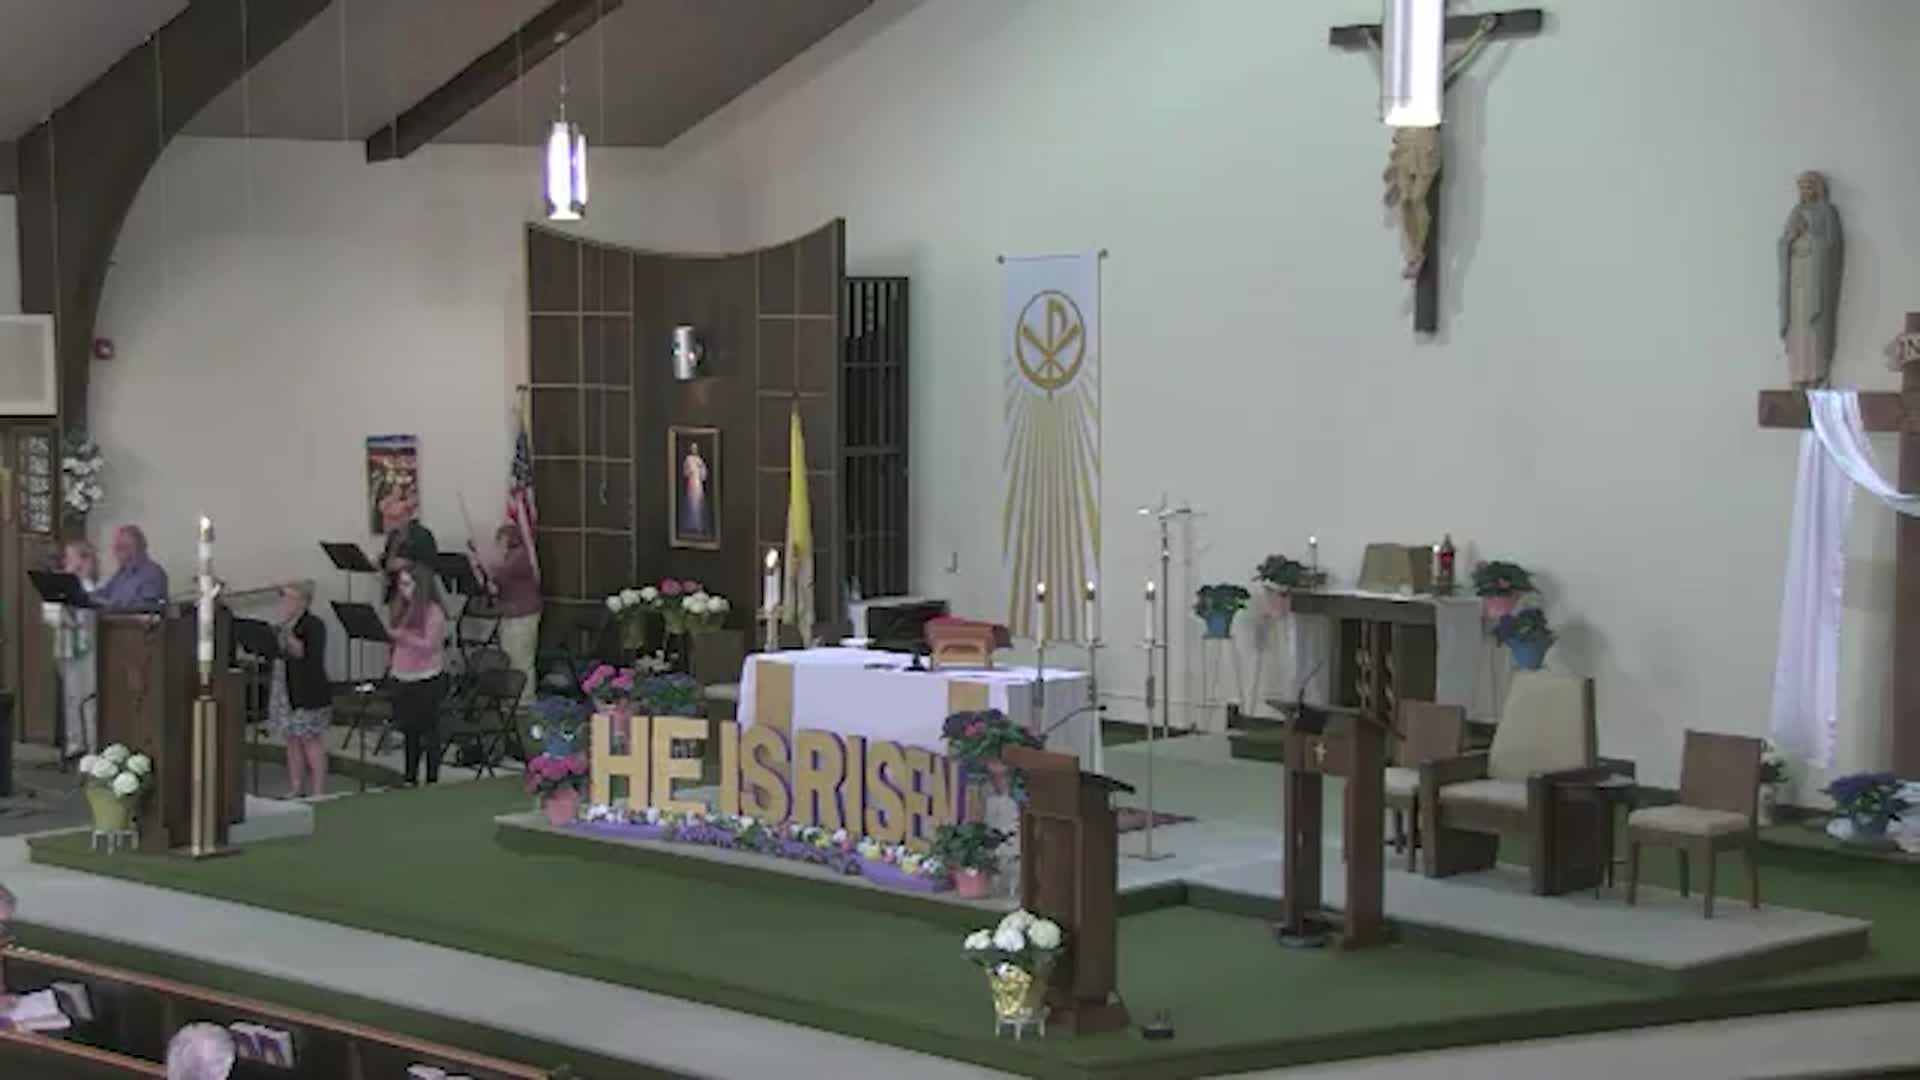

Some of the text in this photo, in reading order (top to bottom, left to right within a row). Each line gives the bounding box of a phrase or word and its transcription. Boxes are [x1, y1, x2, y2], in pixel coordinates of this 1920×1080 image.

[591, 713, 966, 854] HE IS RISEN
